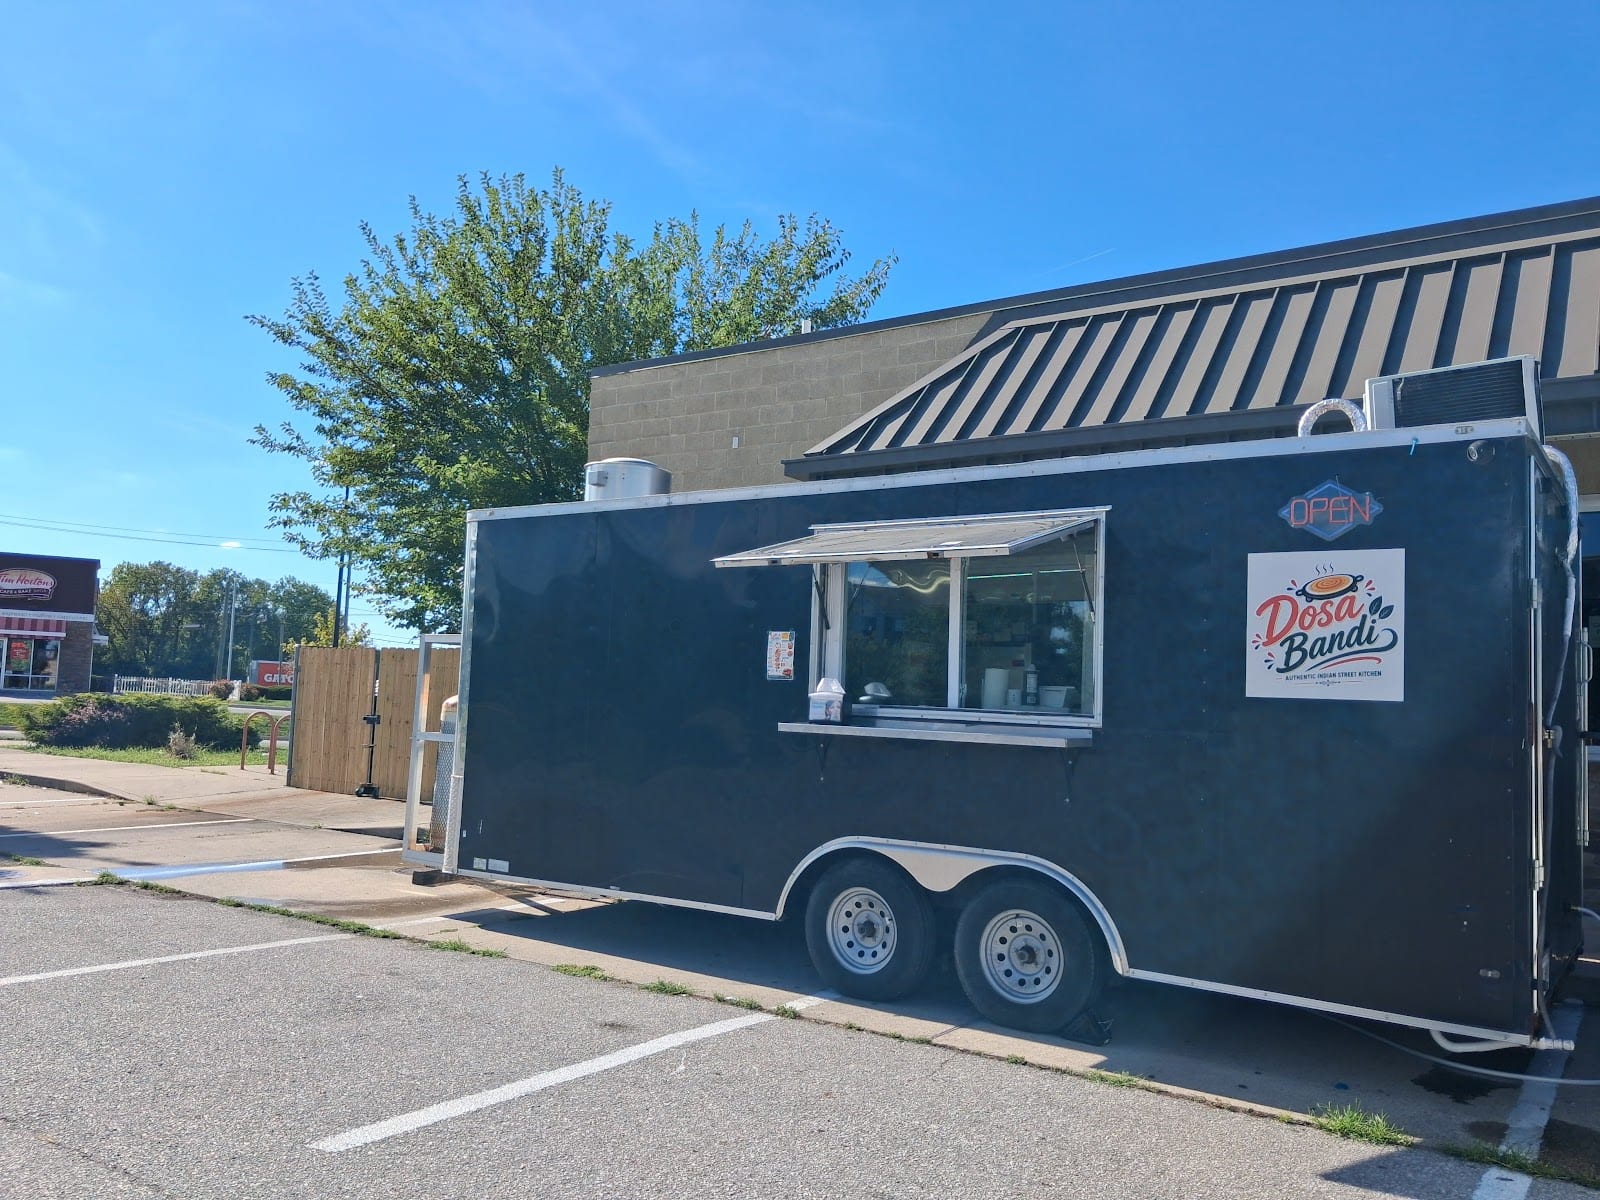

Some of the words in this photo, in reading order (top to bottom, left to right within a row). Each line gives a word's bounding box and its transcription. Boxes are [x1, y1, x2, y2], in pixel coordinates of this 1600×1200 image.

[1290, 496, 1370, 526] OPEN
[1256, 594, 1364, 647] Dosa
[1276, 614, 1380, 673] Bandi
[1285, 673, 1316, 681] AUTHENTIC
